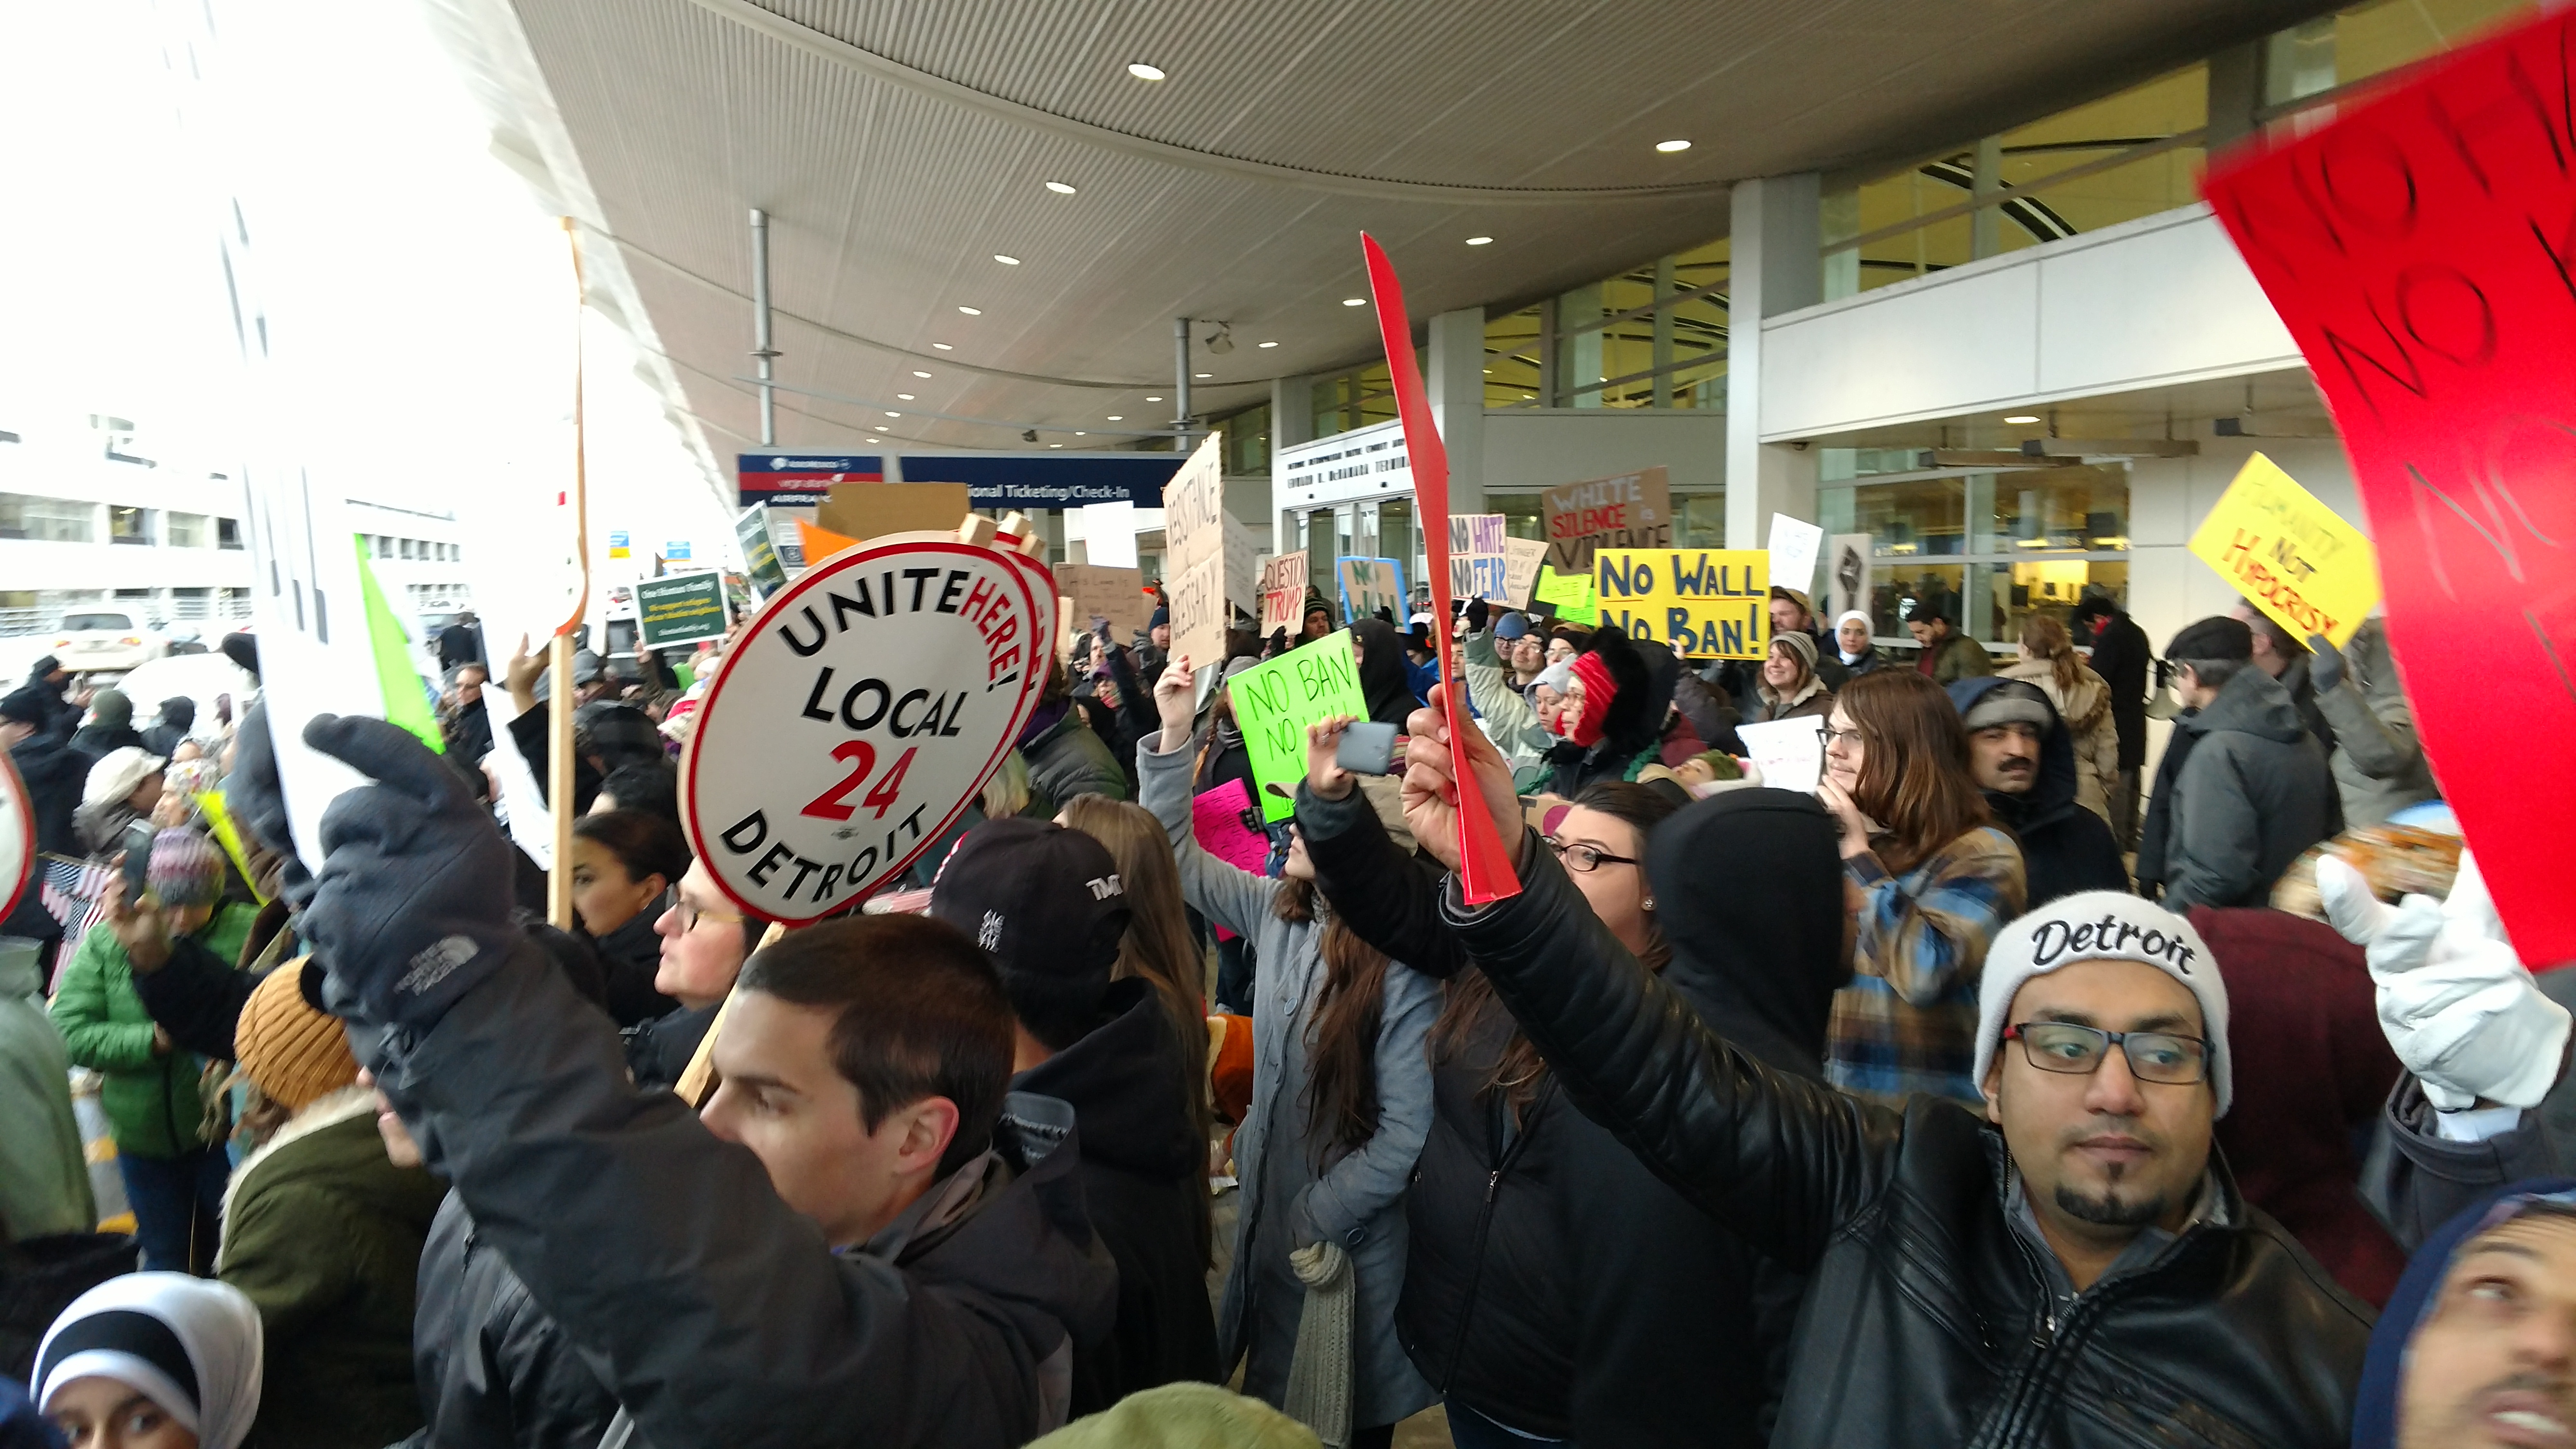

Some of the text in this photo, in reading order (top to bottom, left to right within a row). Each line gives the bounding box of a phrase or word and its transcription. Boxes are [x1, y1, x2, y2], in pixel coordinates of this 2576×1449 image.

[2321, 262, 2498, 428] NO
[1005, 484, 1129, 501] Ticketing/Check-In
[1551, 475, 1643, 512] WHITE
[1449, 516, 1504, 553] NO HATE
[1551, 503, 1626, 539] SILENCE
[1265, 554, 1307, 591] QUESTION
[1451, 557, 1509, 601] NO FEAR
[1600, 553, 1765, 597] NO WALL
[2221, 527, 2340, 635] HYPOCRISY
[2268, 536, 2319, 584] NOT
[1266, 587, 1302, 623] TRUMP
[1601, 609, 1651, 641] NO
[1666, 603, 1760, 655] BAN!
[802, 667, 968, 739] LOCAL
[1246, 670, 1289, 721] NO
[1297, 647, 1352, 701] BAN
[1266, 718, 1297, 762] NO
[799, 738, 920, 822] 24
[719, 802, 928, 904] DETROIT
[2031, 915, 2196, 975] Detroit
